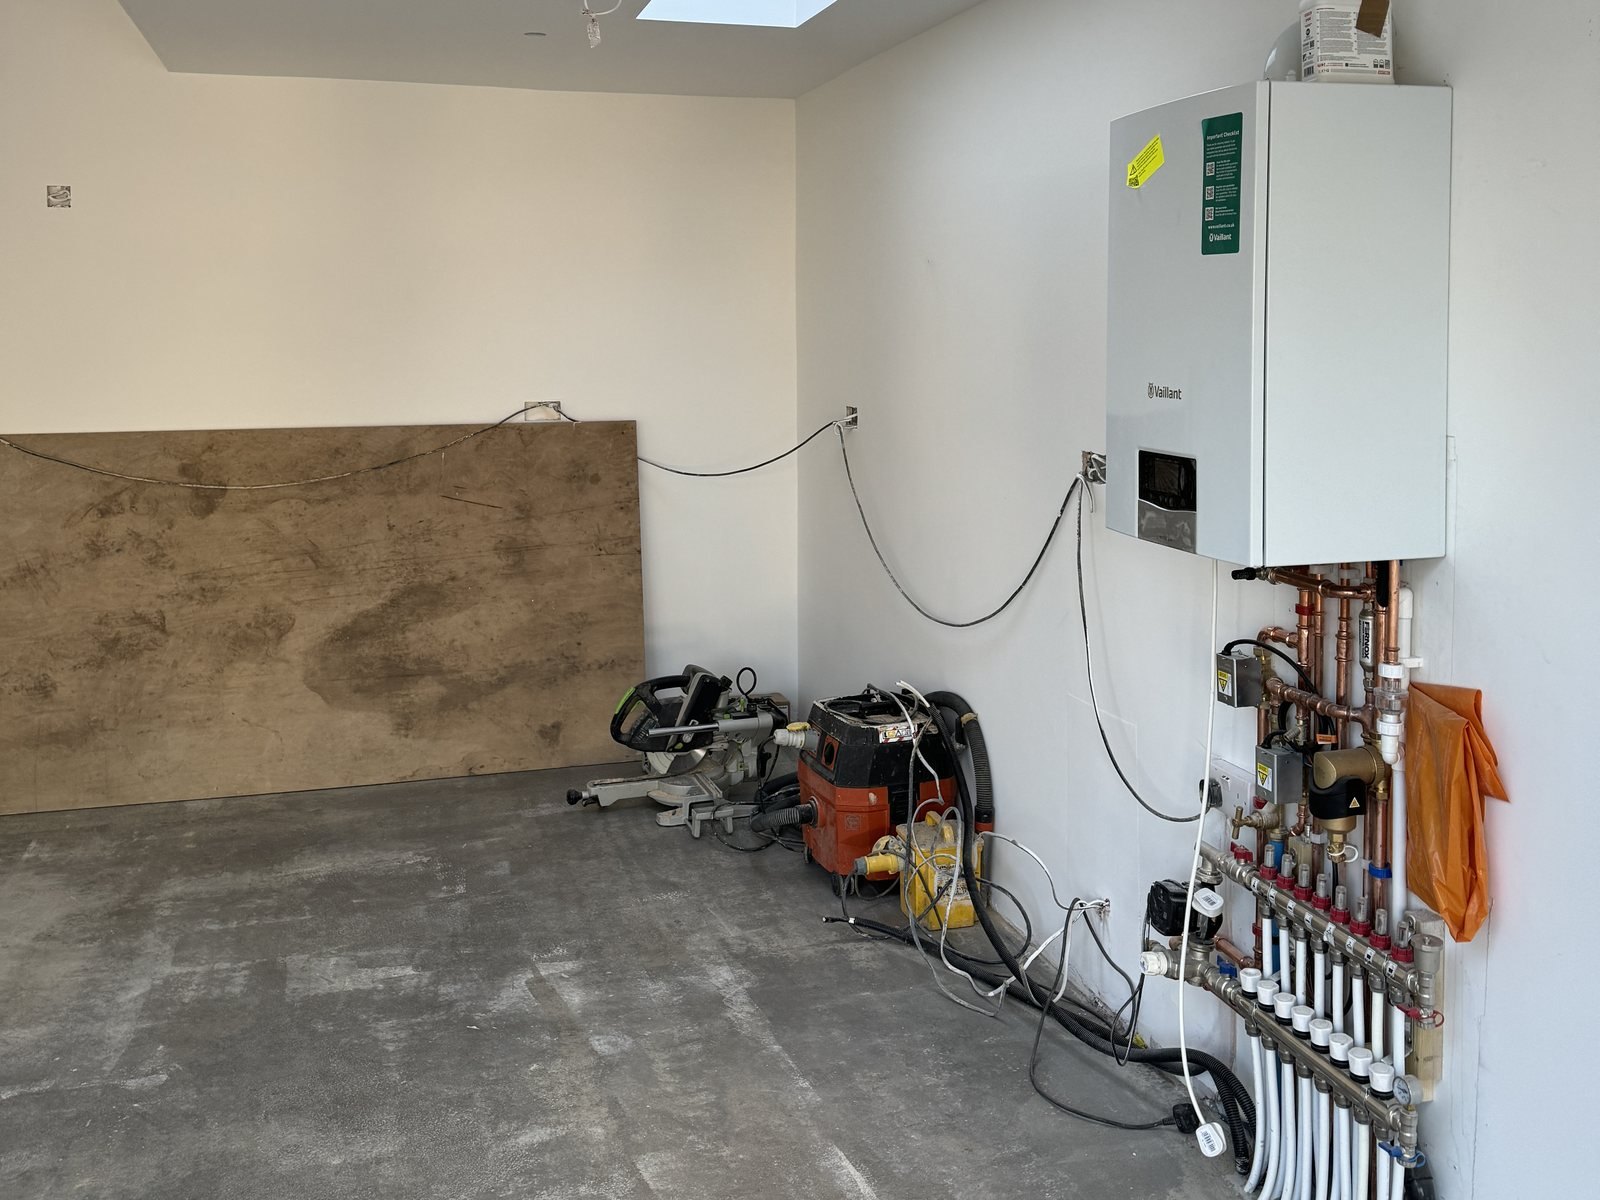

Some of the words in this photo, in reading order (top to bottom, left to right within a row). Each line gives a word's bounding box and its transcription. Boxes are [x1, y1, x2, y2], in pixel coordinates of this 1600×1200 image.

[1206, 133, 1223, 141] Important
[1223, 130, 1240, 138] Checklist
[1213, 233, 1232, 241] Vaillant
[1154, 385, 1182, 400] Vaillant
